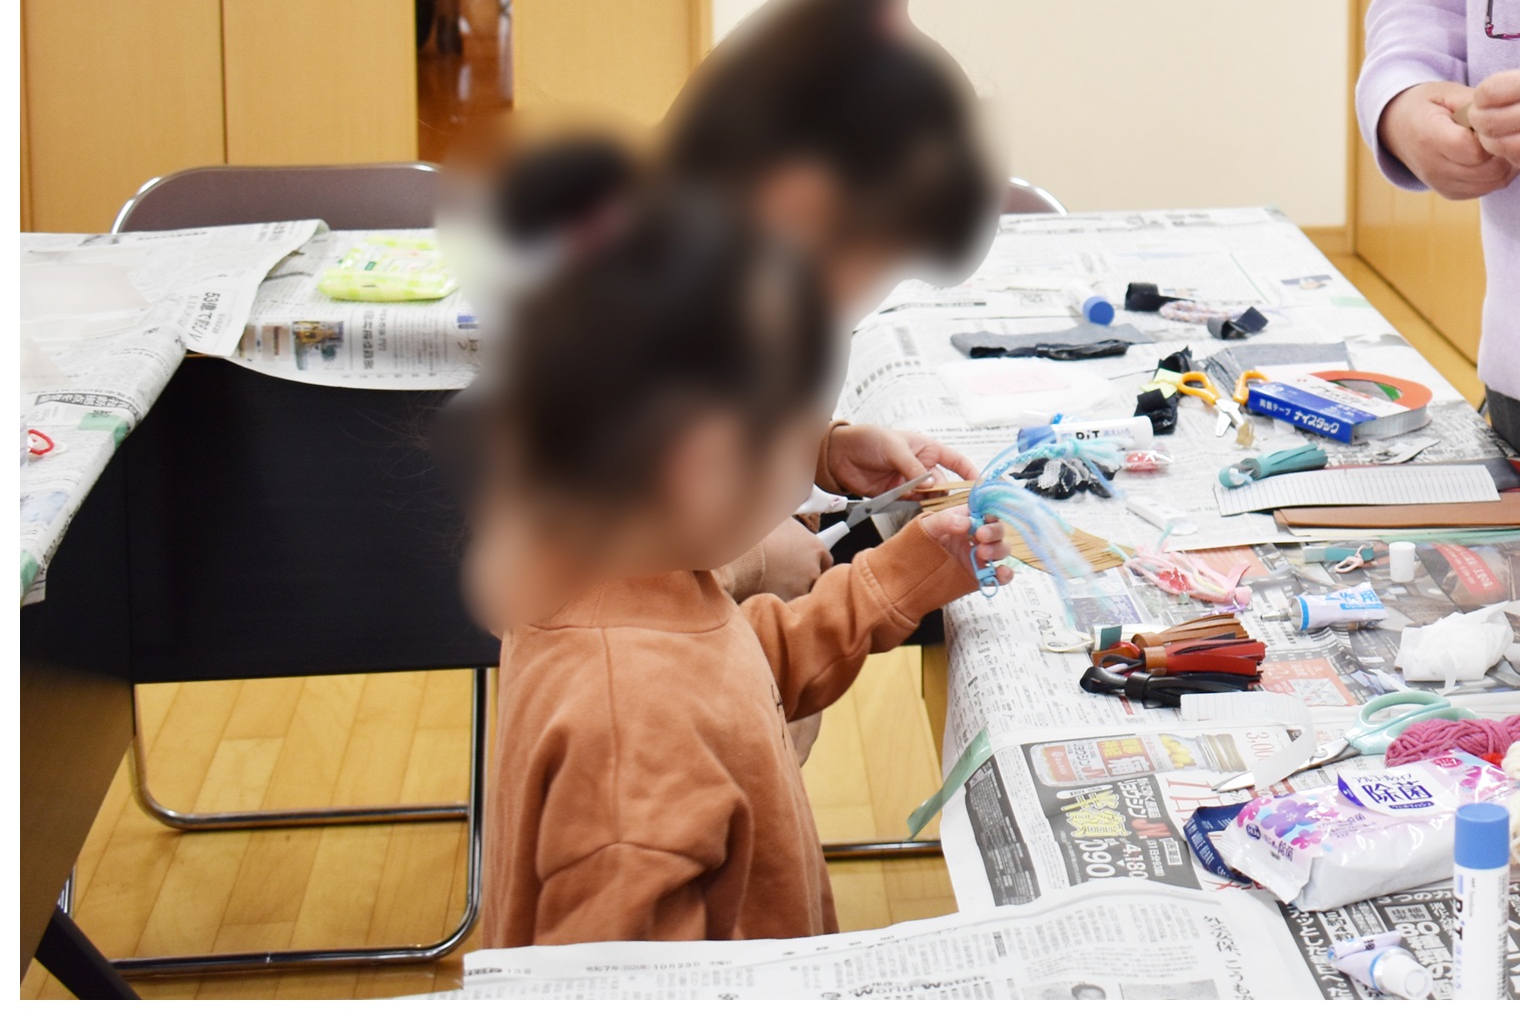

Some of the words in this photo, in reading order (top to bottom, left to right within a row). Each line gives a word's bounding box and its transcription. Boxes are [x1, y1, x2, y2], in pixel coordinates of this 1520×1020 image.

[1260, 398, 1291, 416] 両面テープ
[1294, 411, 1340, 434] ナイスタック
[1076, 430, 1101, 440] PiT
[1361, 780, 1433, 804] 除菌
[1199, 845, 1214, 865] HEART
[854, 984, 916, 998] World
[922, 975, 986, 991] Watch
